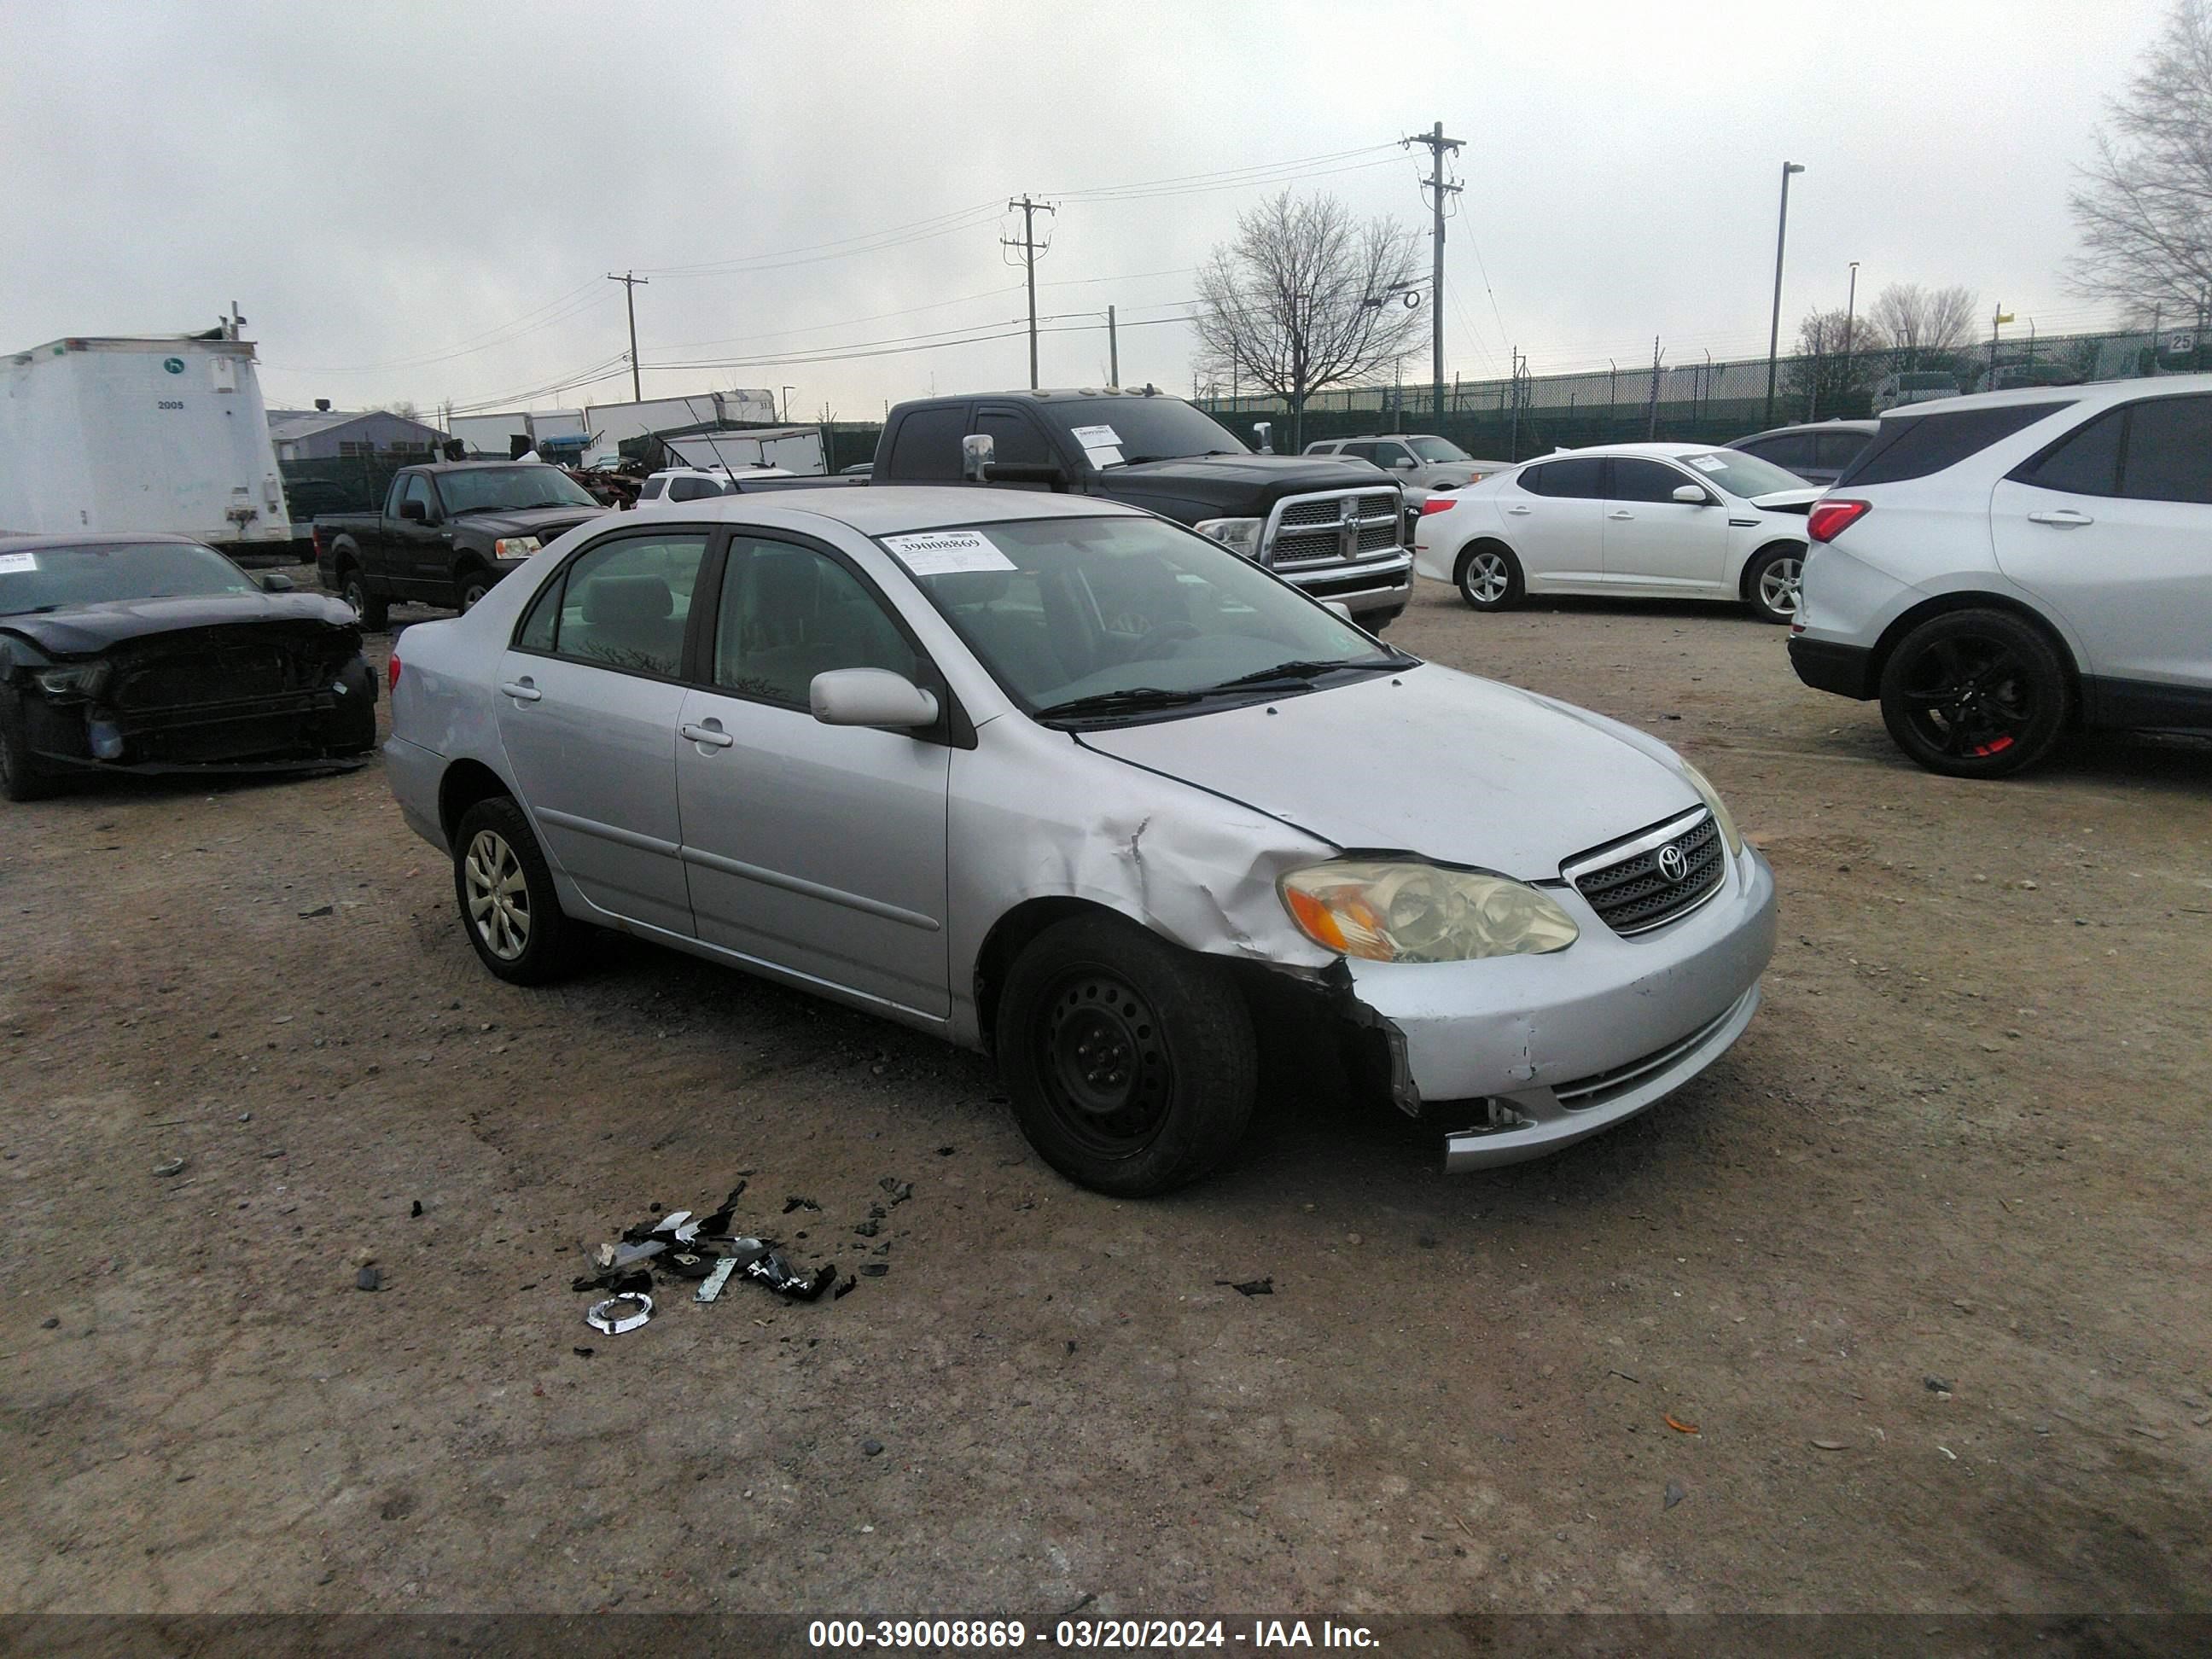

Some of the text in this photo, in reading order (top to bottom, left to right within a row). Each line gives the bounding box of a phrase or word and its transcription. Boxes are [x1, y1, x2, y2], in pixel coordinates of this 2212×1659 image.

[2171, 335, 2192, 349] 25
[158, 401, 184, 410] 2005
[900, 538, 981, 552] 39008869
